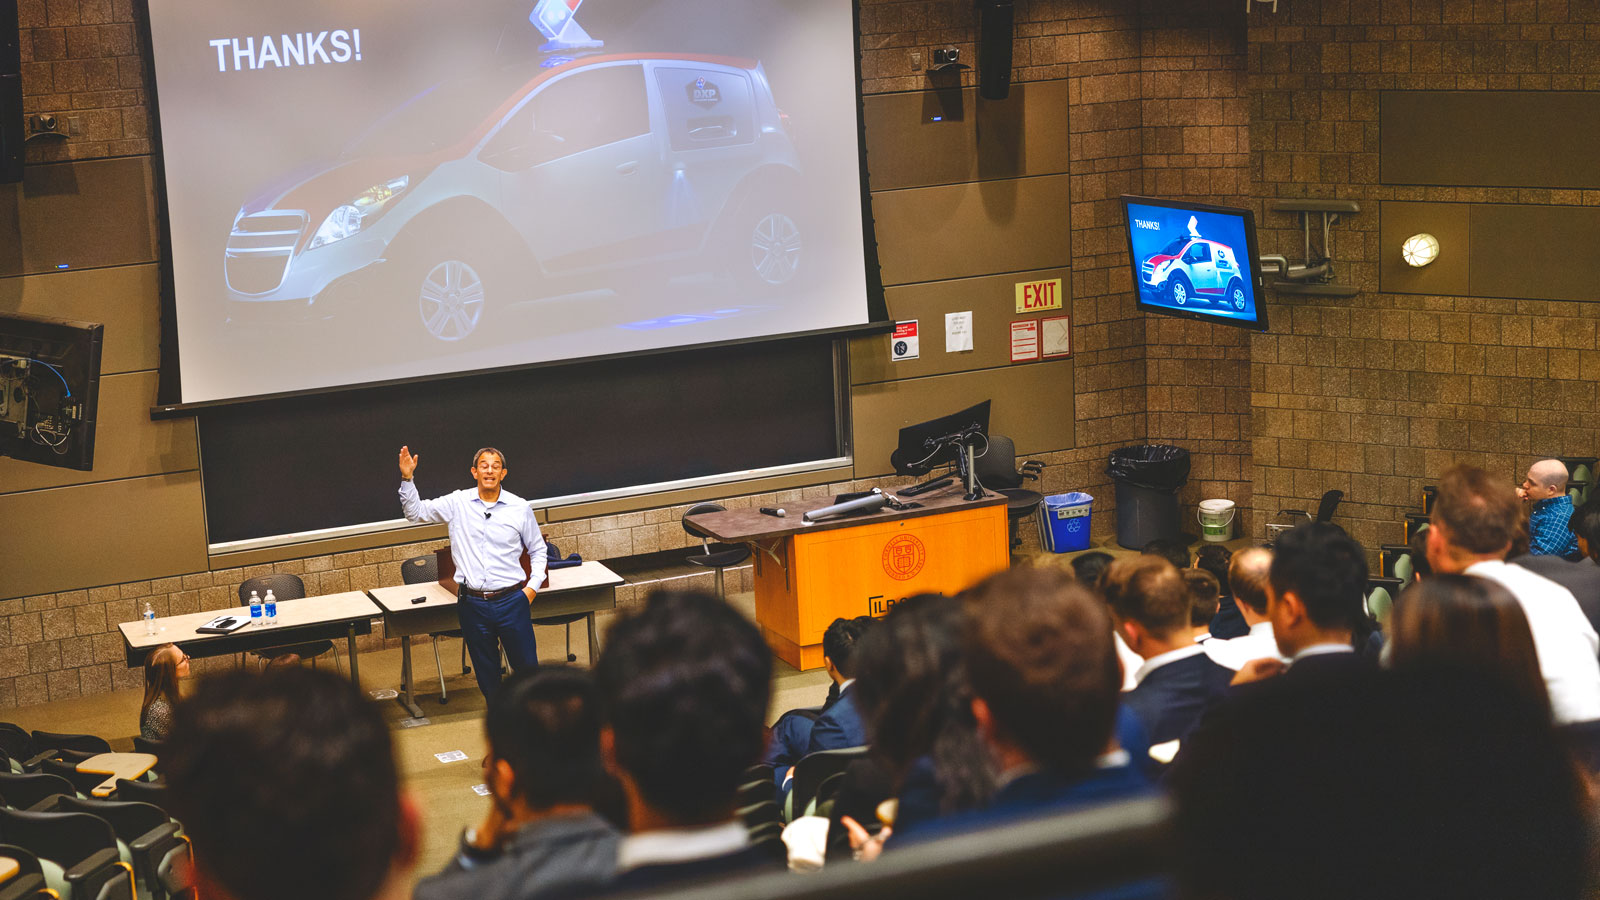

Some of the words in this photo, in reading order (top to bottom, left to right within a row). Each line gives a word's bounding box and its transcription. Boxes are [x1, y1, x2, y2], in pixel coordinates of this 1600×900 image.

[209, 28, 362, 72] THANKS!
[1135, 219, 1160, 230] THANKS!
[1023, 281, 1057, 309] EXIT
